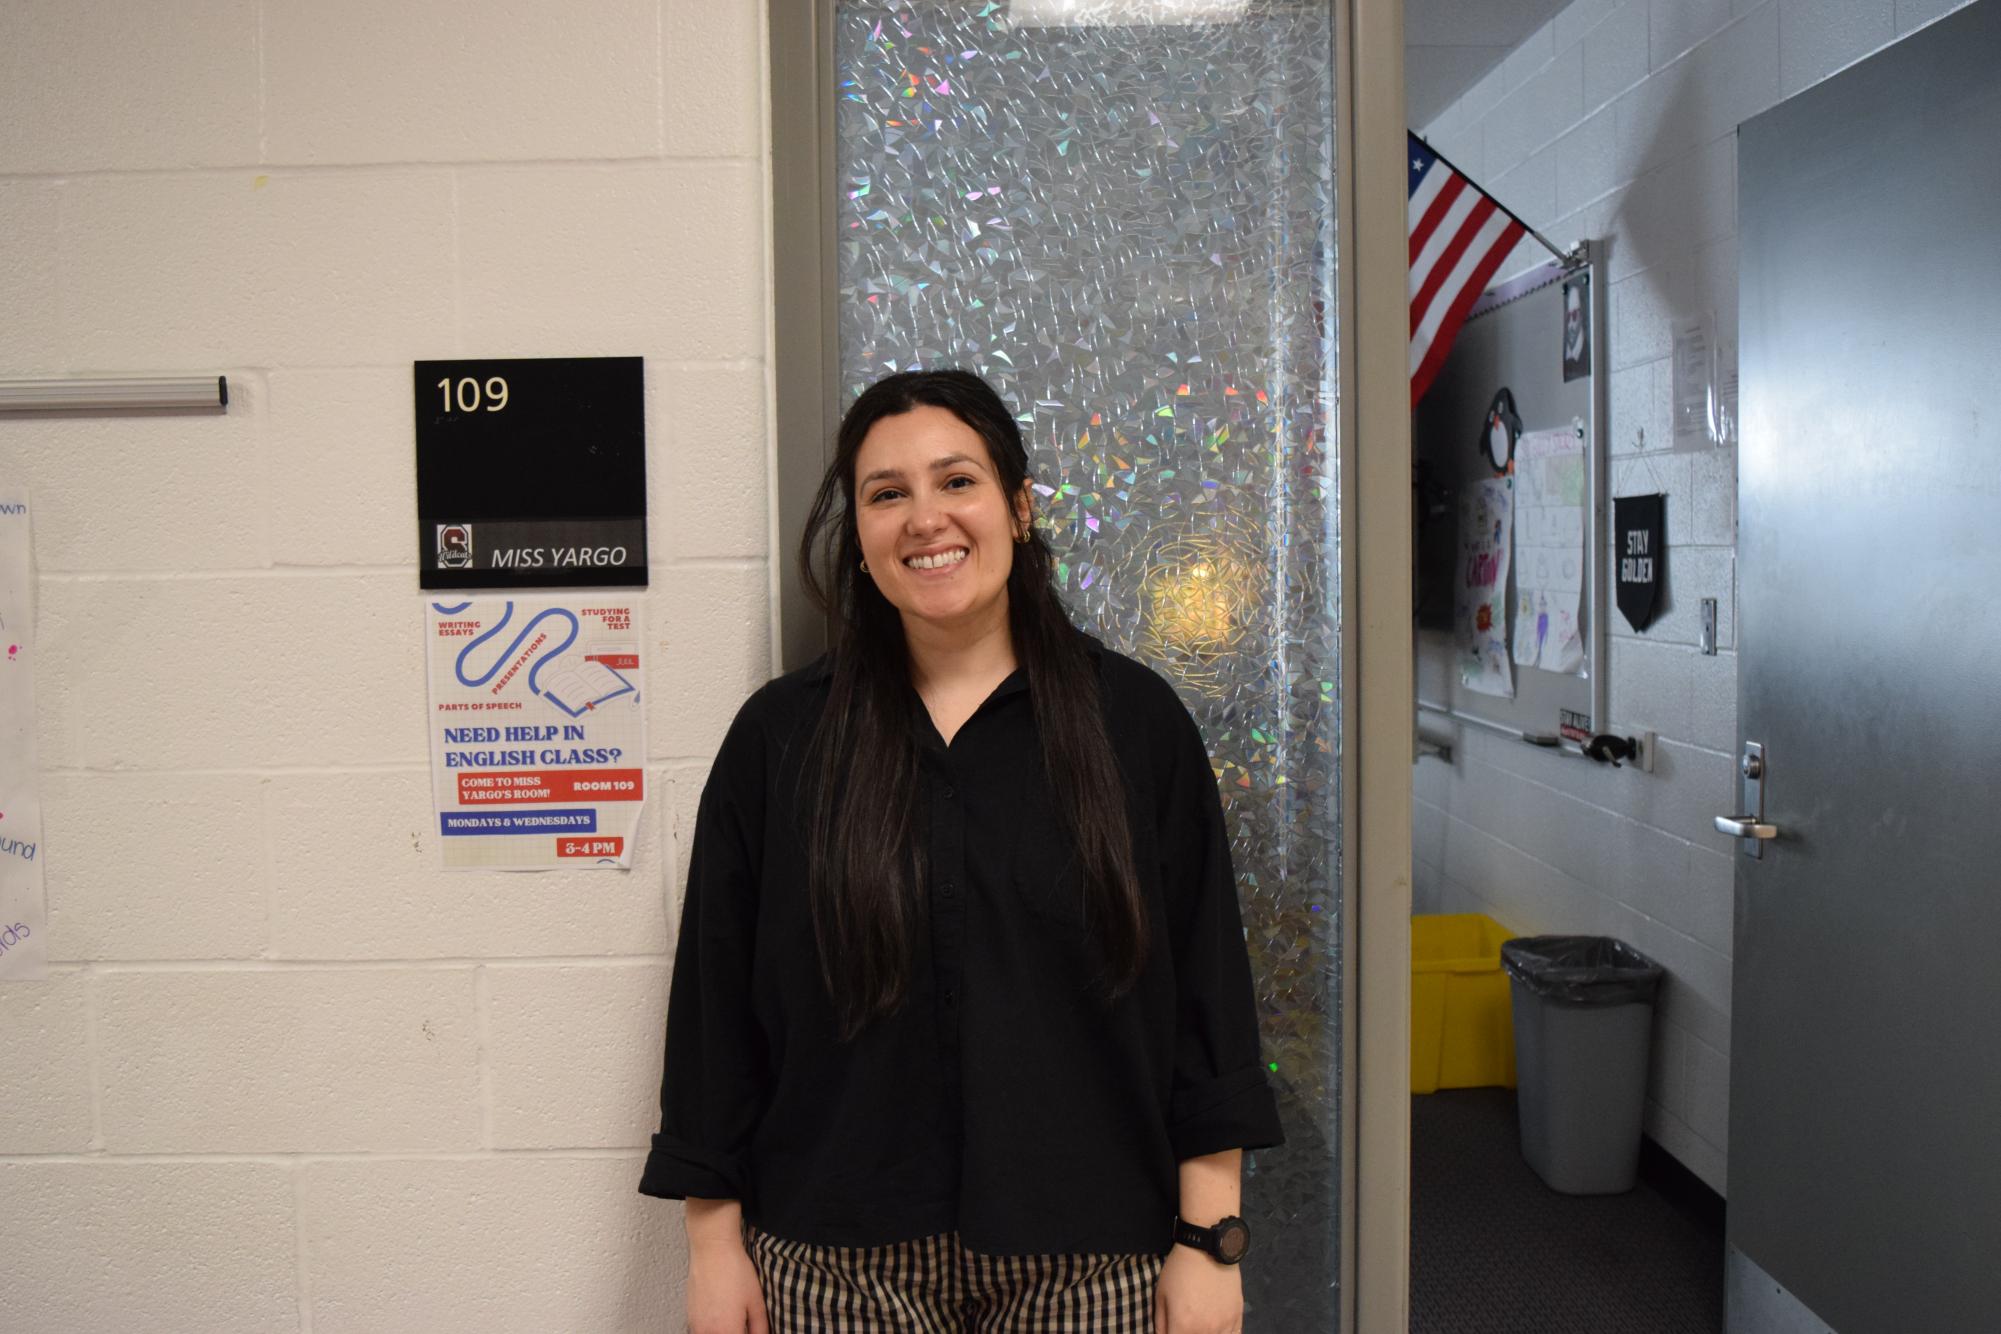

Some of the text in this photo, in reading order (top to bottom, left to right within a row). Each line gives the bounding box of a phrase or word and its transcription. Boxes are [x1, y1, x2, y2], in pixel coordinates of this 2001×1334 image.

[437, 376, 509, 412] 109
[1626, 529, 1649, 555] STAY
[491, 547, 627, 568] MISS YARGO
[1621, 557, 1653, 583] GOLDEN
[581, 608, 631, 616] STUDYING
[438, 621, 481, 629] WRITING
[623, 615, 631, 623] A
[607, 622, 631, 630] TEST
[491, 632, 547, 696] PRESENTATIONS
[438, 702, 522, 711] PARTS OF SPEECH
[444, 725, 585, 743] NEED HELP IN
[445, 748, 622, 767] ENGLISH CLASS?
[461, 776, 541, 787] COME TO MISS
[573, 781, 635, 791] ROOM 109
[462, 788, 551, 800] YARGO'S ROOM!
[448, 815, 591, 828] MONDAYS & WEDNESDAYS
[0, 836, 36, 861] und
[565, 842, 615, 854] 3-4 PM
